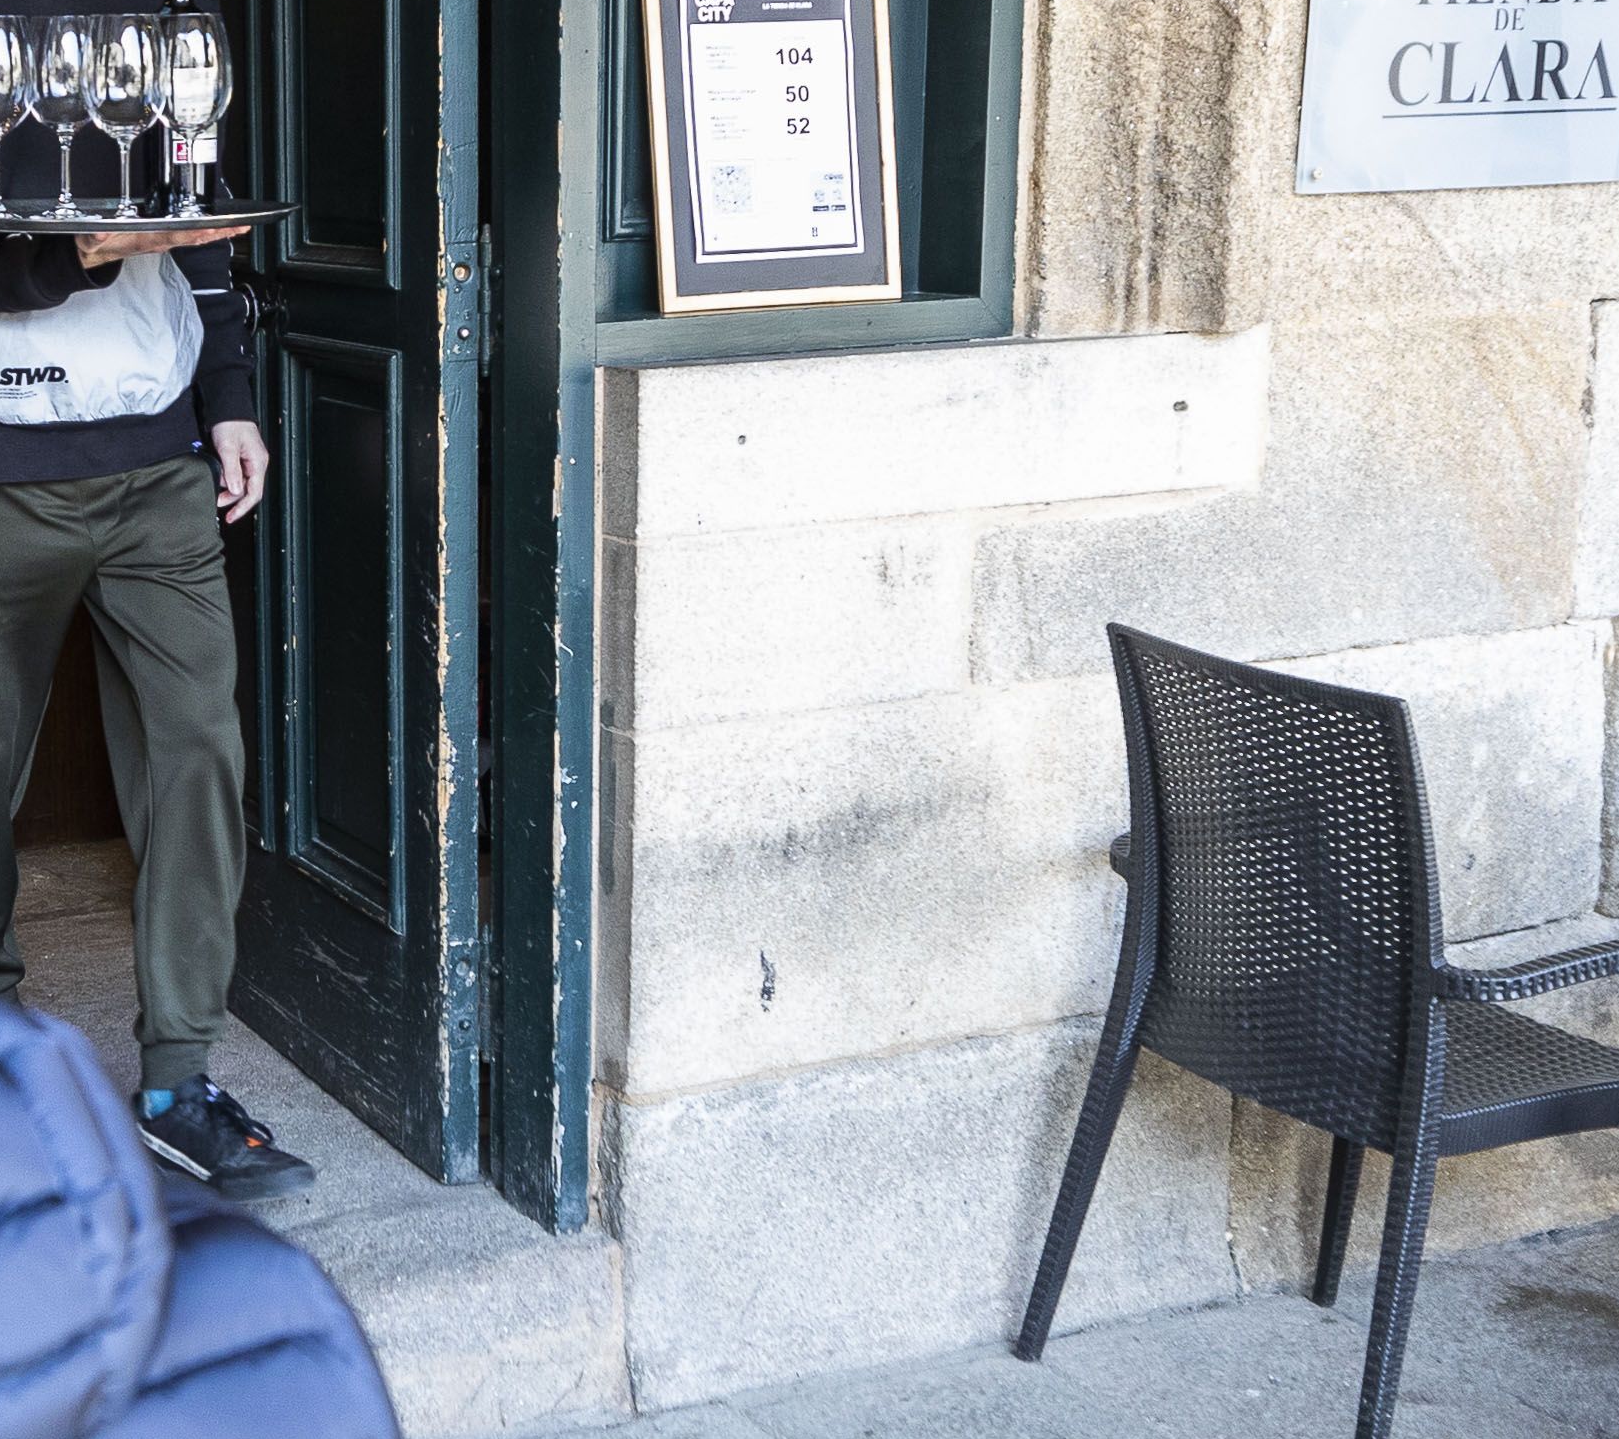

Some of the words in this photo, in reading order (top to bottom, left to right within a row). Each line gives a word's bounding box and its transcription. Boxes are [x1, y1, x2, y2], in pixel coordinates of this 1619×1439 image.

[697, 5, 733, 22] CITY
[1494, 7, 1526, 31] DE
[776, 47, 813, 65] 104
[1388, 38, 1618, 106] CLARA
[786, 85, 809, 102] 50
[787, 117, 810, 134] 52
